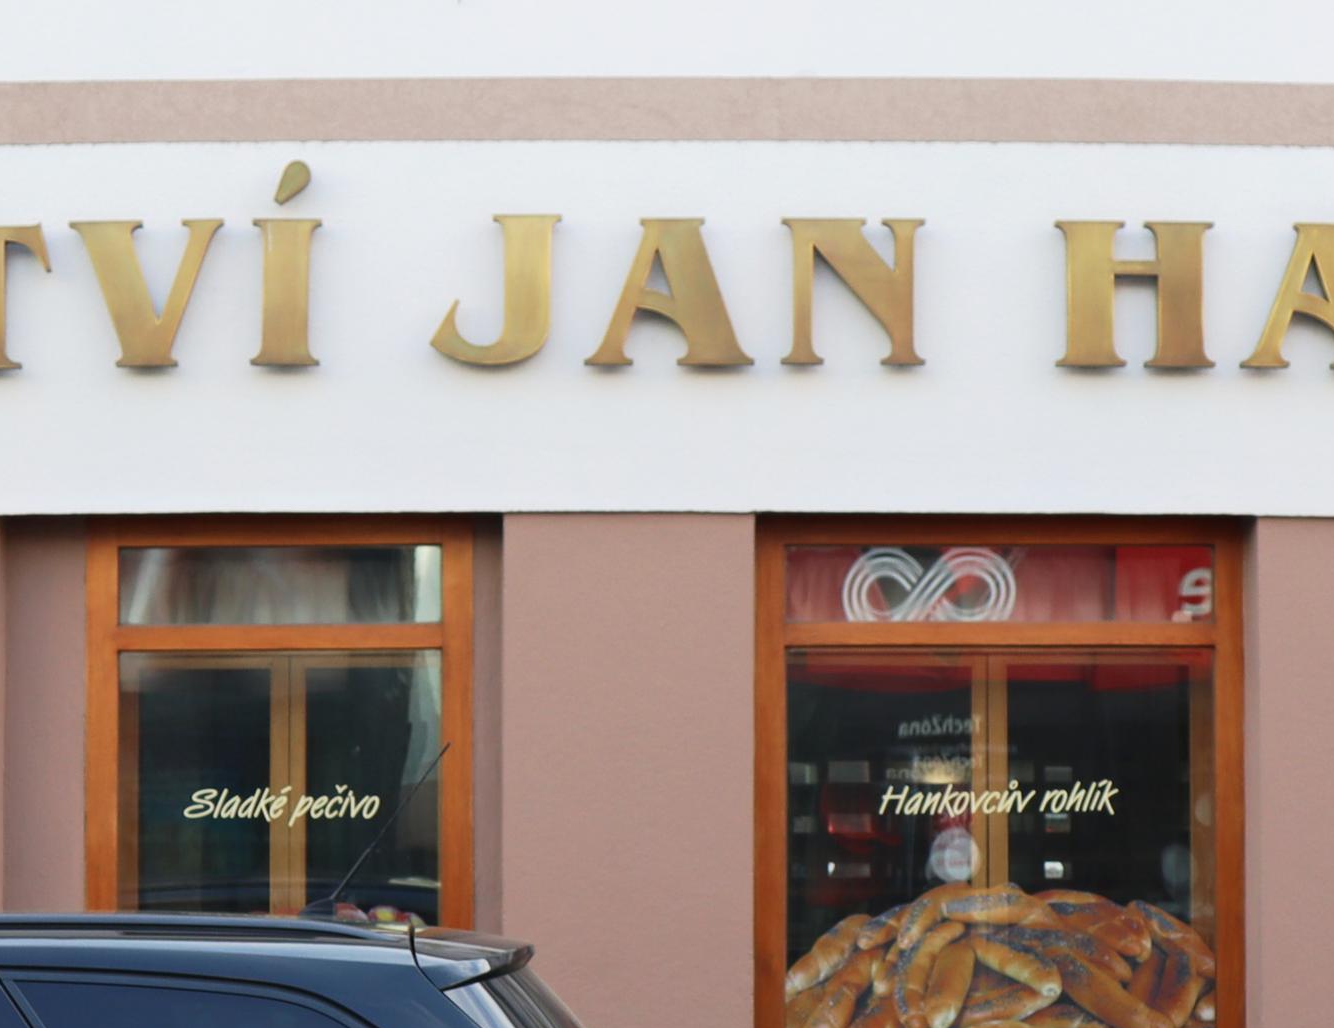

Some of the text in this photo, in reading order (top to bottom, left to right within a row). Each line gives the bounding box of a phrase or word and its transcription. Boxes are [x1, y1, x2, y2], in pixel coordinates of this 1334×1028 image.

[430, 214, 925, 366] JAN
[183, 784, 381, 827] Sladké pečivo
[878, 779, 1120, 818] Hankovcův rohlík
